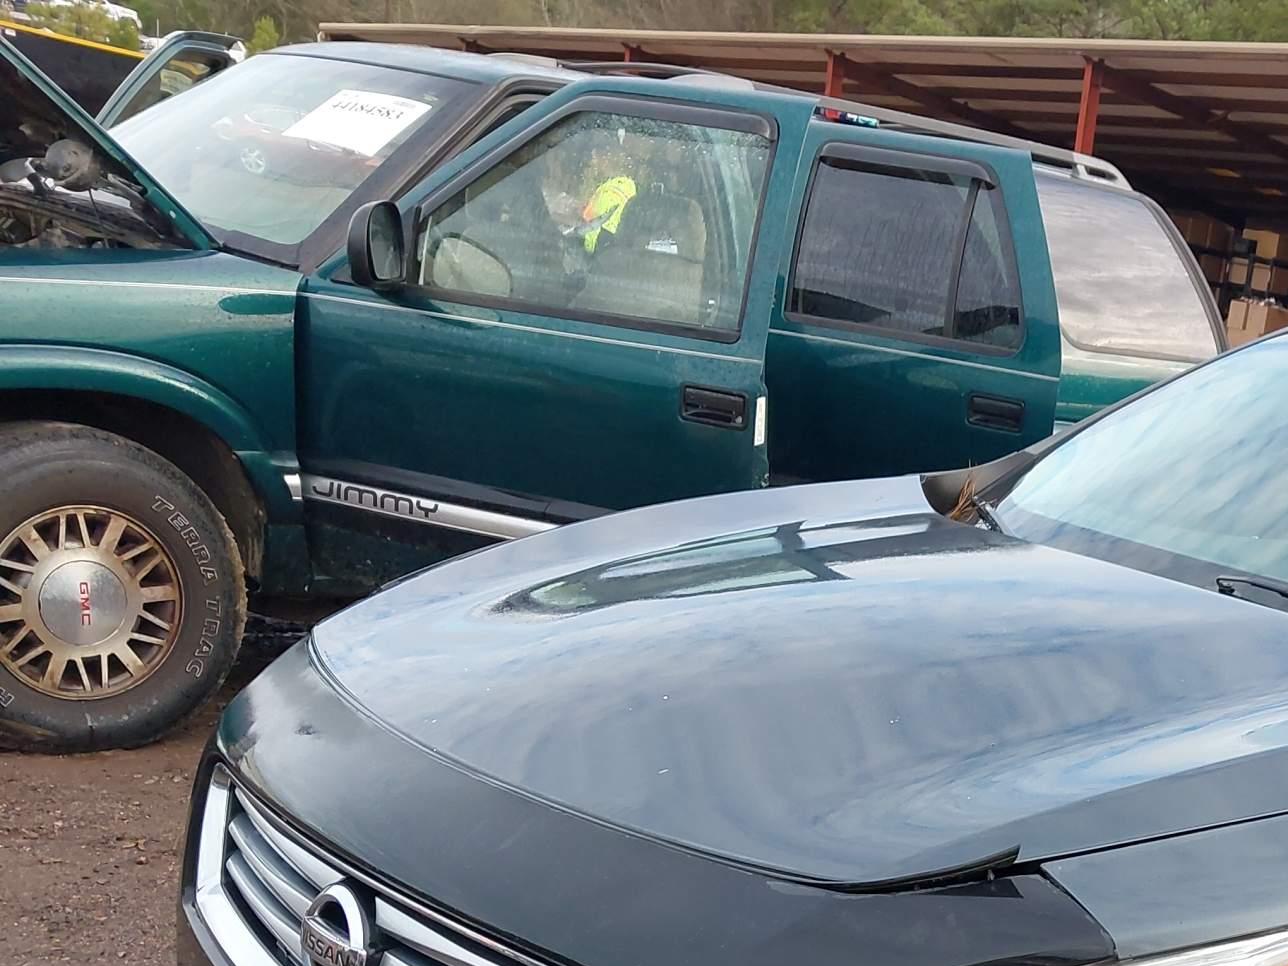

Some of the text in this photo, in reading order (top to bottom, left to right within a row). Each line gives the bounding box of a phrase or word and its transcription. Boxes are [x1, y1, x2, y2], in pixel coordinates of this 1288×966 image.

[312, 481, 439, 519] JIMMY
[78, 581, 93, 626] GMC
[151, 495, 222, 678] TERRA TRAC
